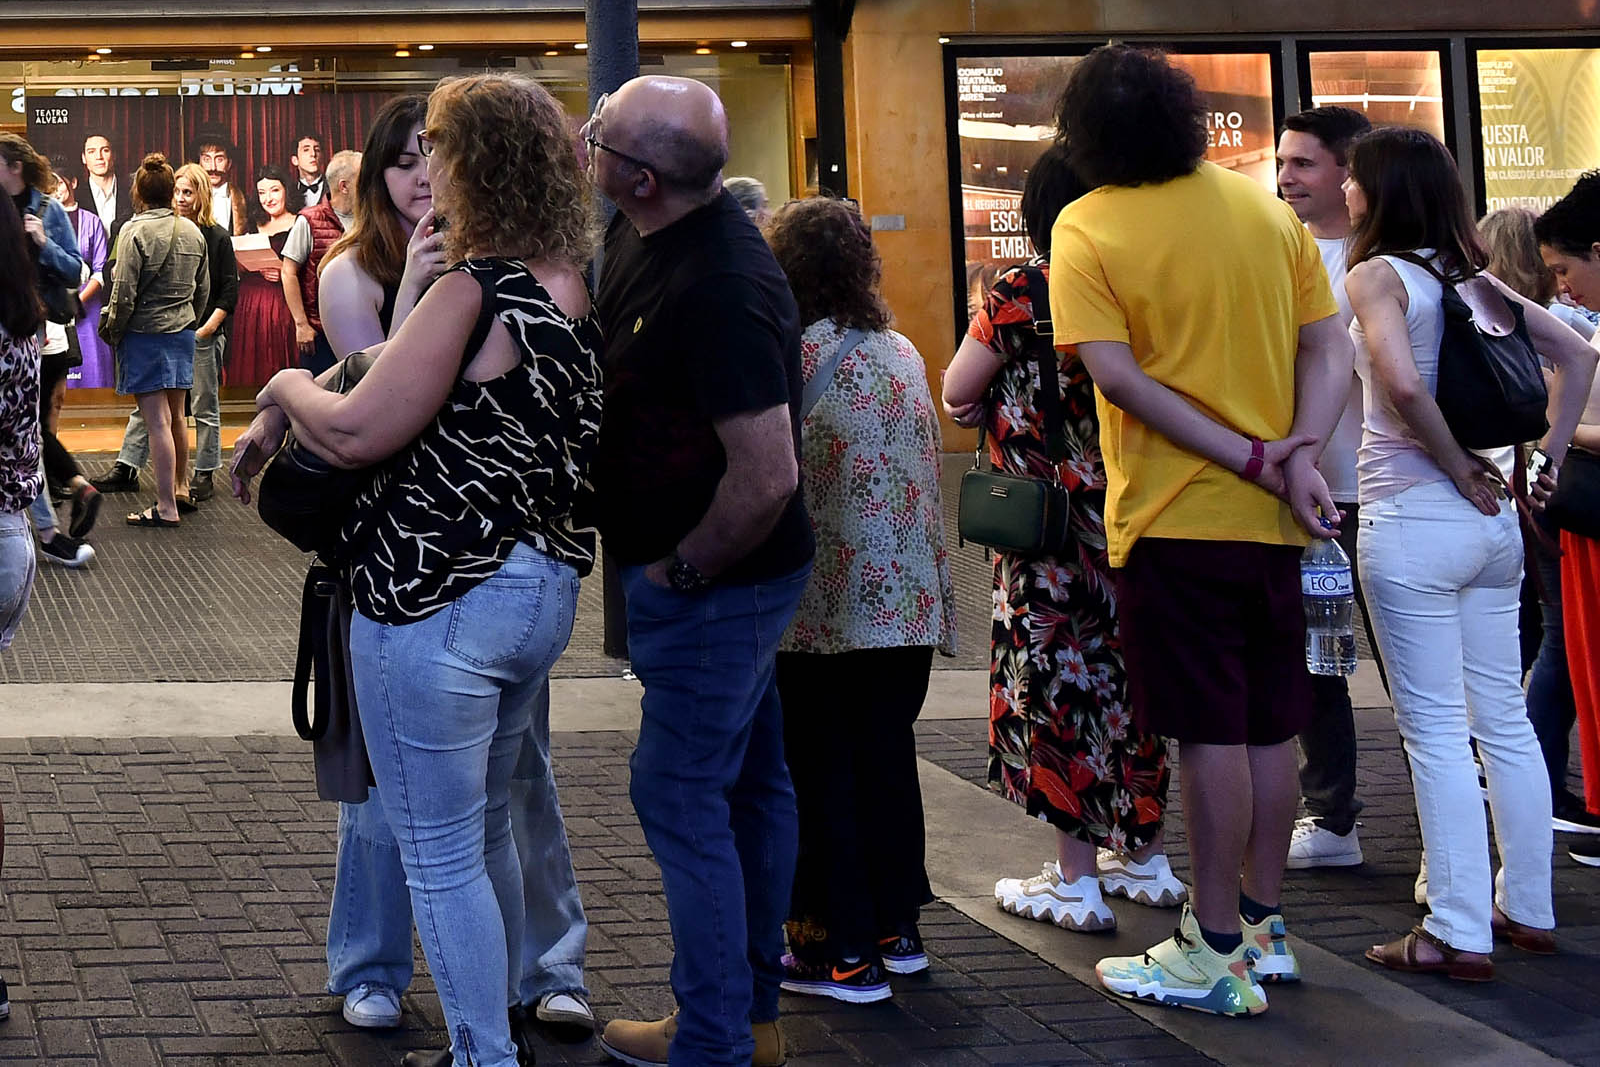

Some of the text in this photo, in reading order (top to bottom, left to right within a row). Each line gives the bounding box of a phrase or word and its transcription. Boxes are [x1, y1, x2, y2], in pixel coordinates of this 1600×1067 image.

[957, 68, 1004, 77] COMPLEJO
[958, 77, 996, 85] TEATRAL
[958, 85, 1007, 94] DE BUENOS
[960, 93, 985, 102] AIRES
[35, 109, 68, 117] TEATRO
[35, 116, 68, 124] ALVEAR
[1205, 111, 1243, 129] TRO
[1206, 130, 1243, 147] EAR
[1498, 147, 1545, 167] VALOR
[964, 199, 974, 210] EL
[975, 199, 1011, 210] REGRESO
[991, 237, 1035, 259] EMBL
[1311, 575, 1338, 593] ECO
